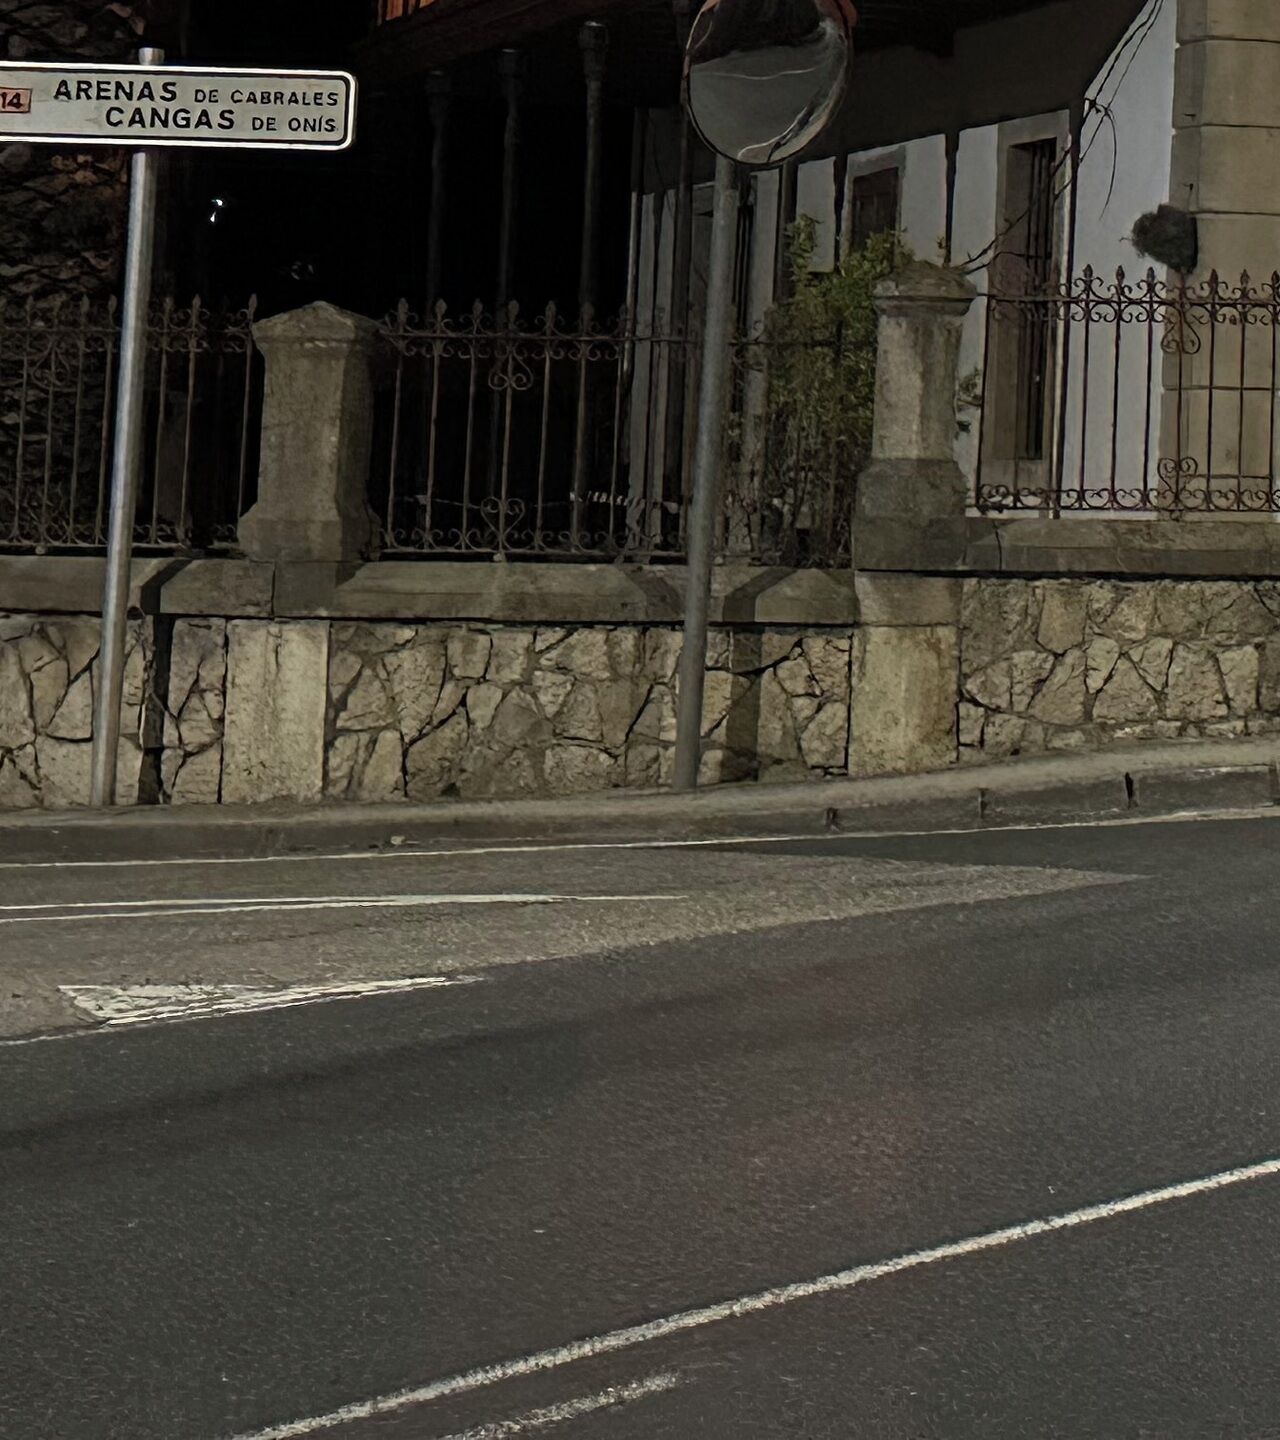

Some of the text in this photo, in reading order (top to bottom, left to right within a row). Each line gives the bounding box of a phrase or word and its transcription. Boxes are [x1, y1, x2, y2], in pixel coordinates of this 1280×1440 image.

[53, 79, 339, 106] ARENAS DE CABRALES
[105, 106, 337, 133] CANGAS DE ONÍS
